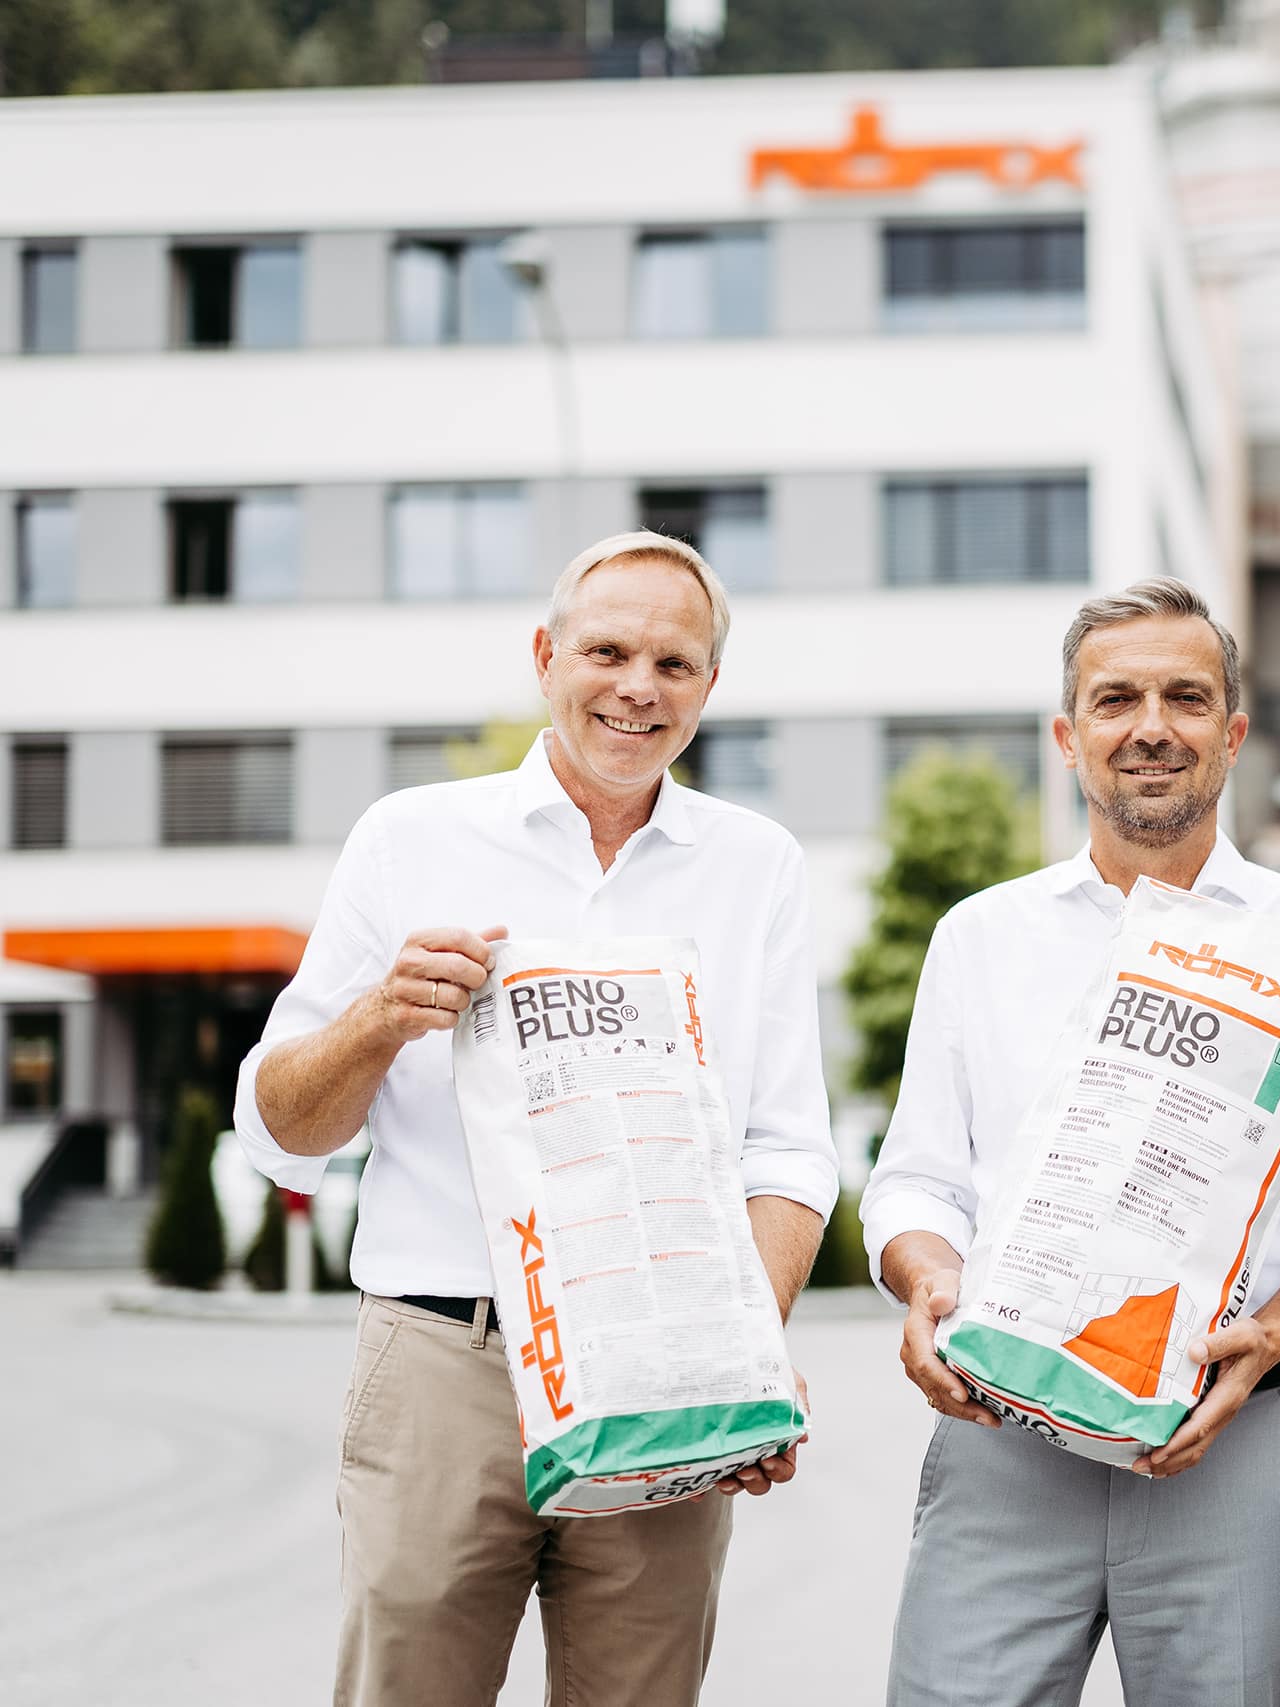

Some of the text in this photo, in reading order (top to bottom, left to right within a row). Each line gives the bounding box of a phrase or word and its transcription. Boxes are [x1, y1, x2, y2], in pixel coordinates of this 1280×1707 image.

[510, 978, 625, 1019] RENO
[679, 970, 706, 1067] RÖFIX
[1108, 986, 1221, 1042] RENO
[1135, 1157, 1172, 1179] UNIVERSALE
[1170, 1152, 1187, 1164] SUVA
[510, 1205, 574, 1422] RÖFIX
[999, 1305, 1021, 1323] KG
